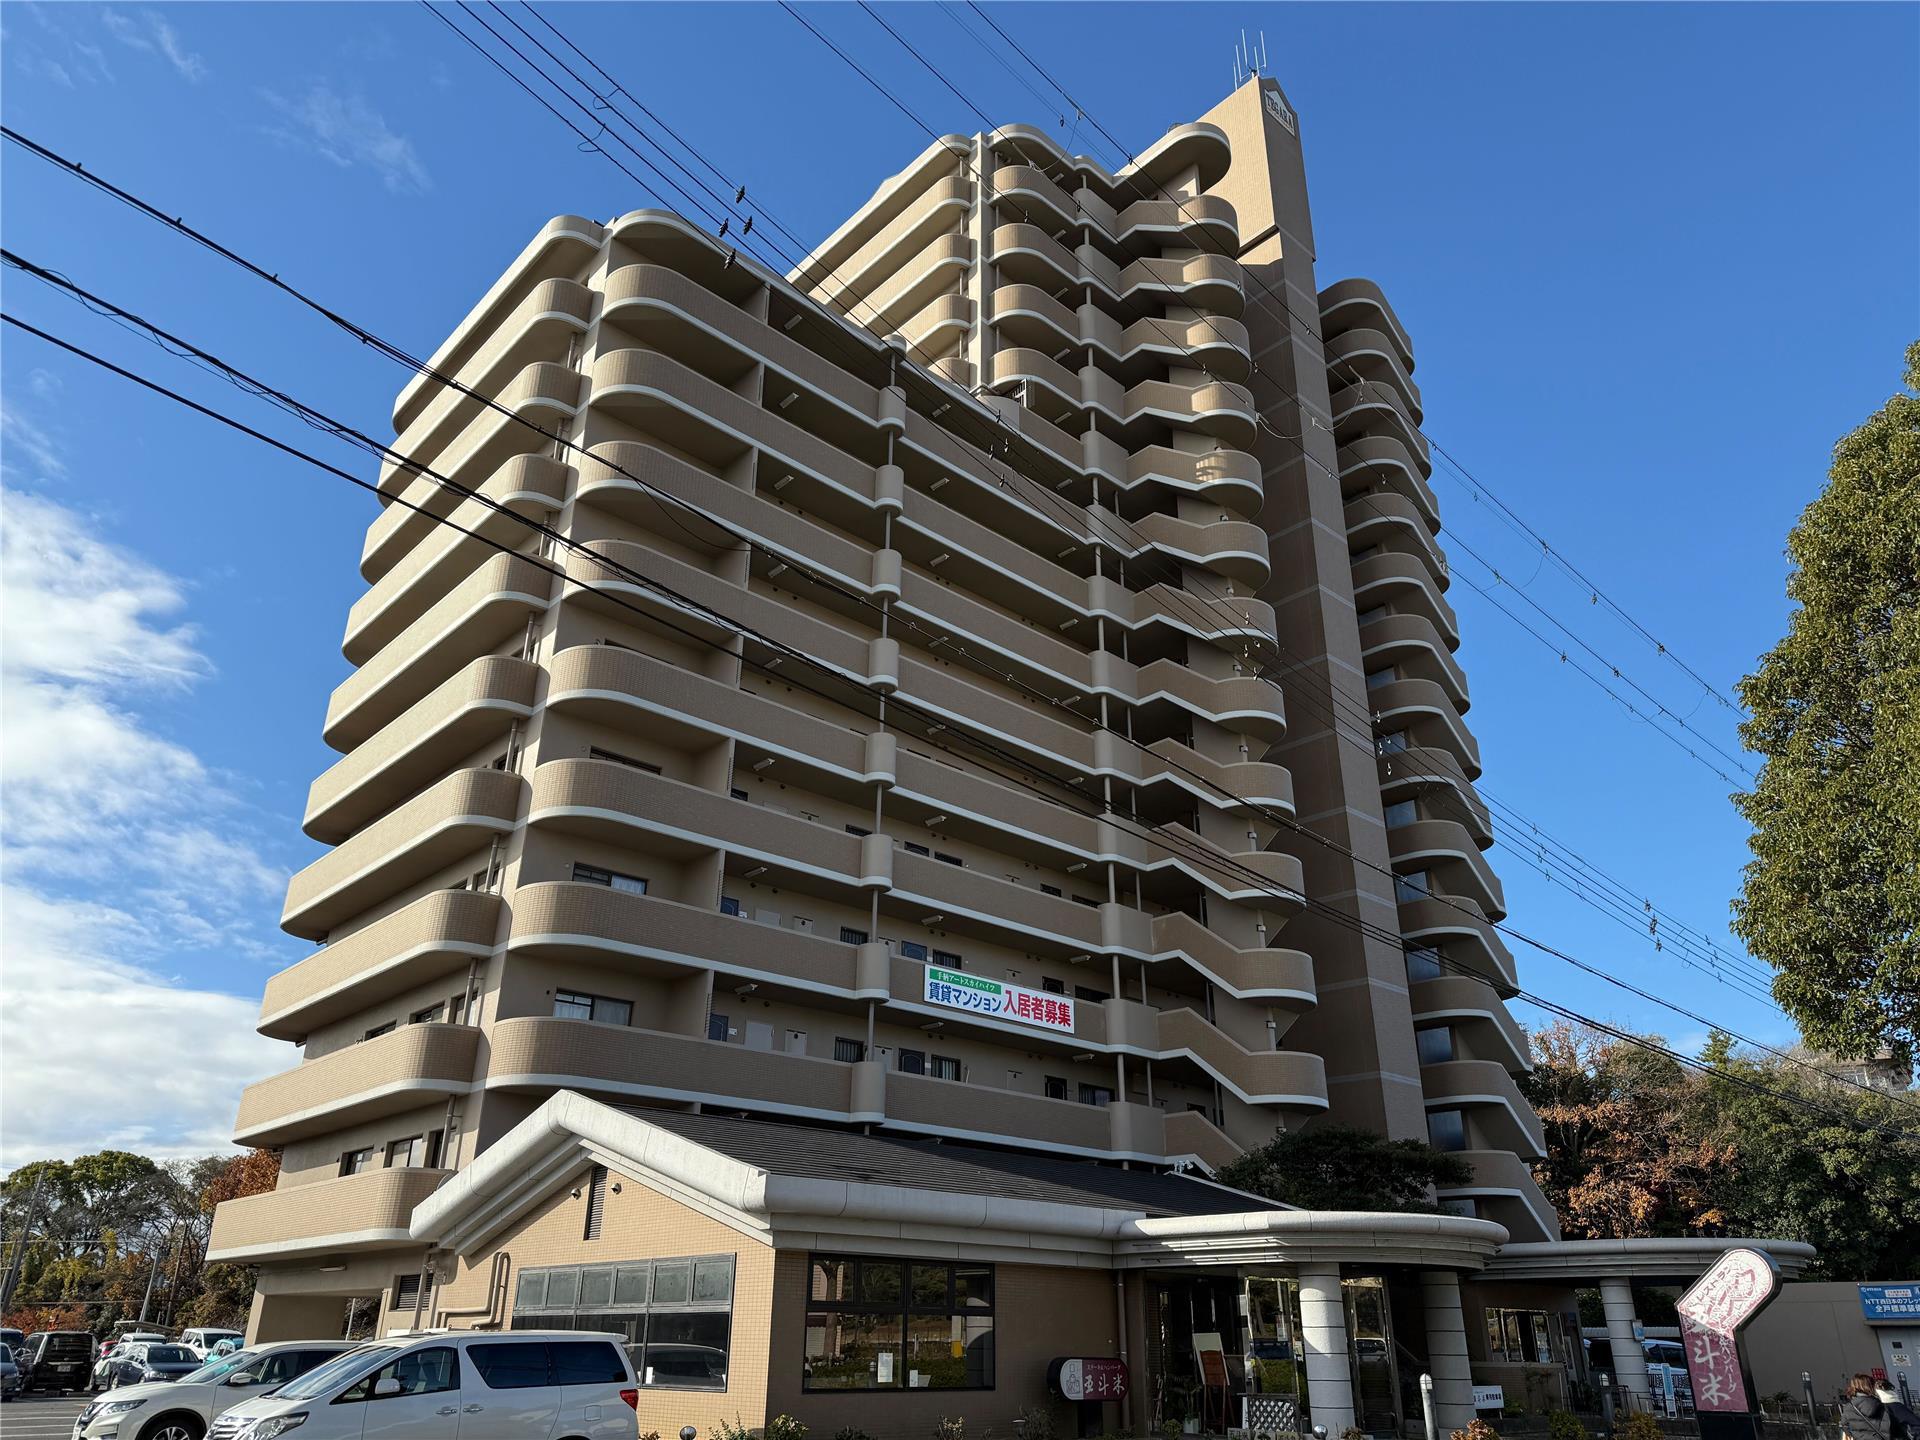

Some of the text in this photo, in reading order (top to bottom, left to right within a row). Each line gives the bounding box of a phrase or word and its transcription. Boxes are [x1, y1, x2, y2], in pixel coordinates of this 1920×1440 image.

[929, 981, 1071, 1027] 賃貸マンション 入居者募集
